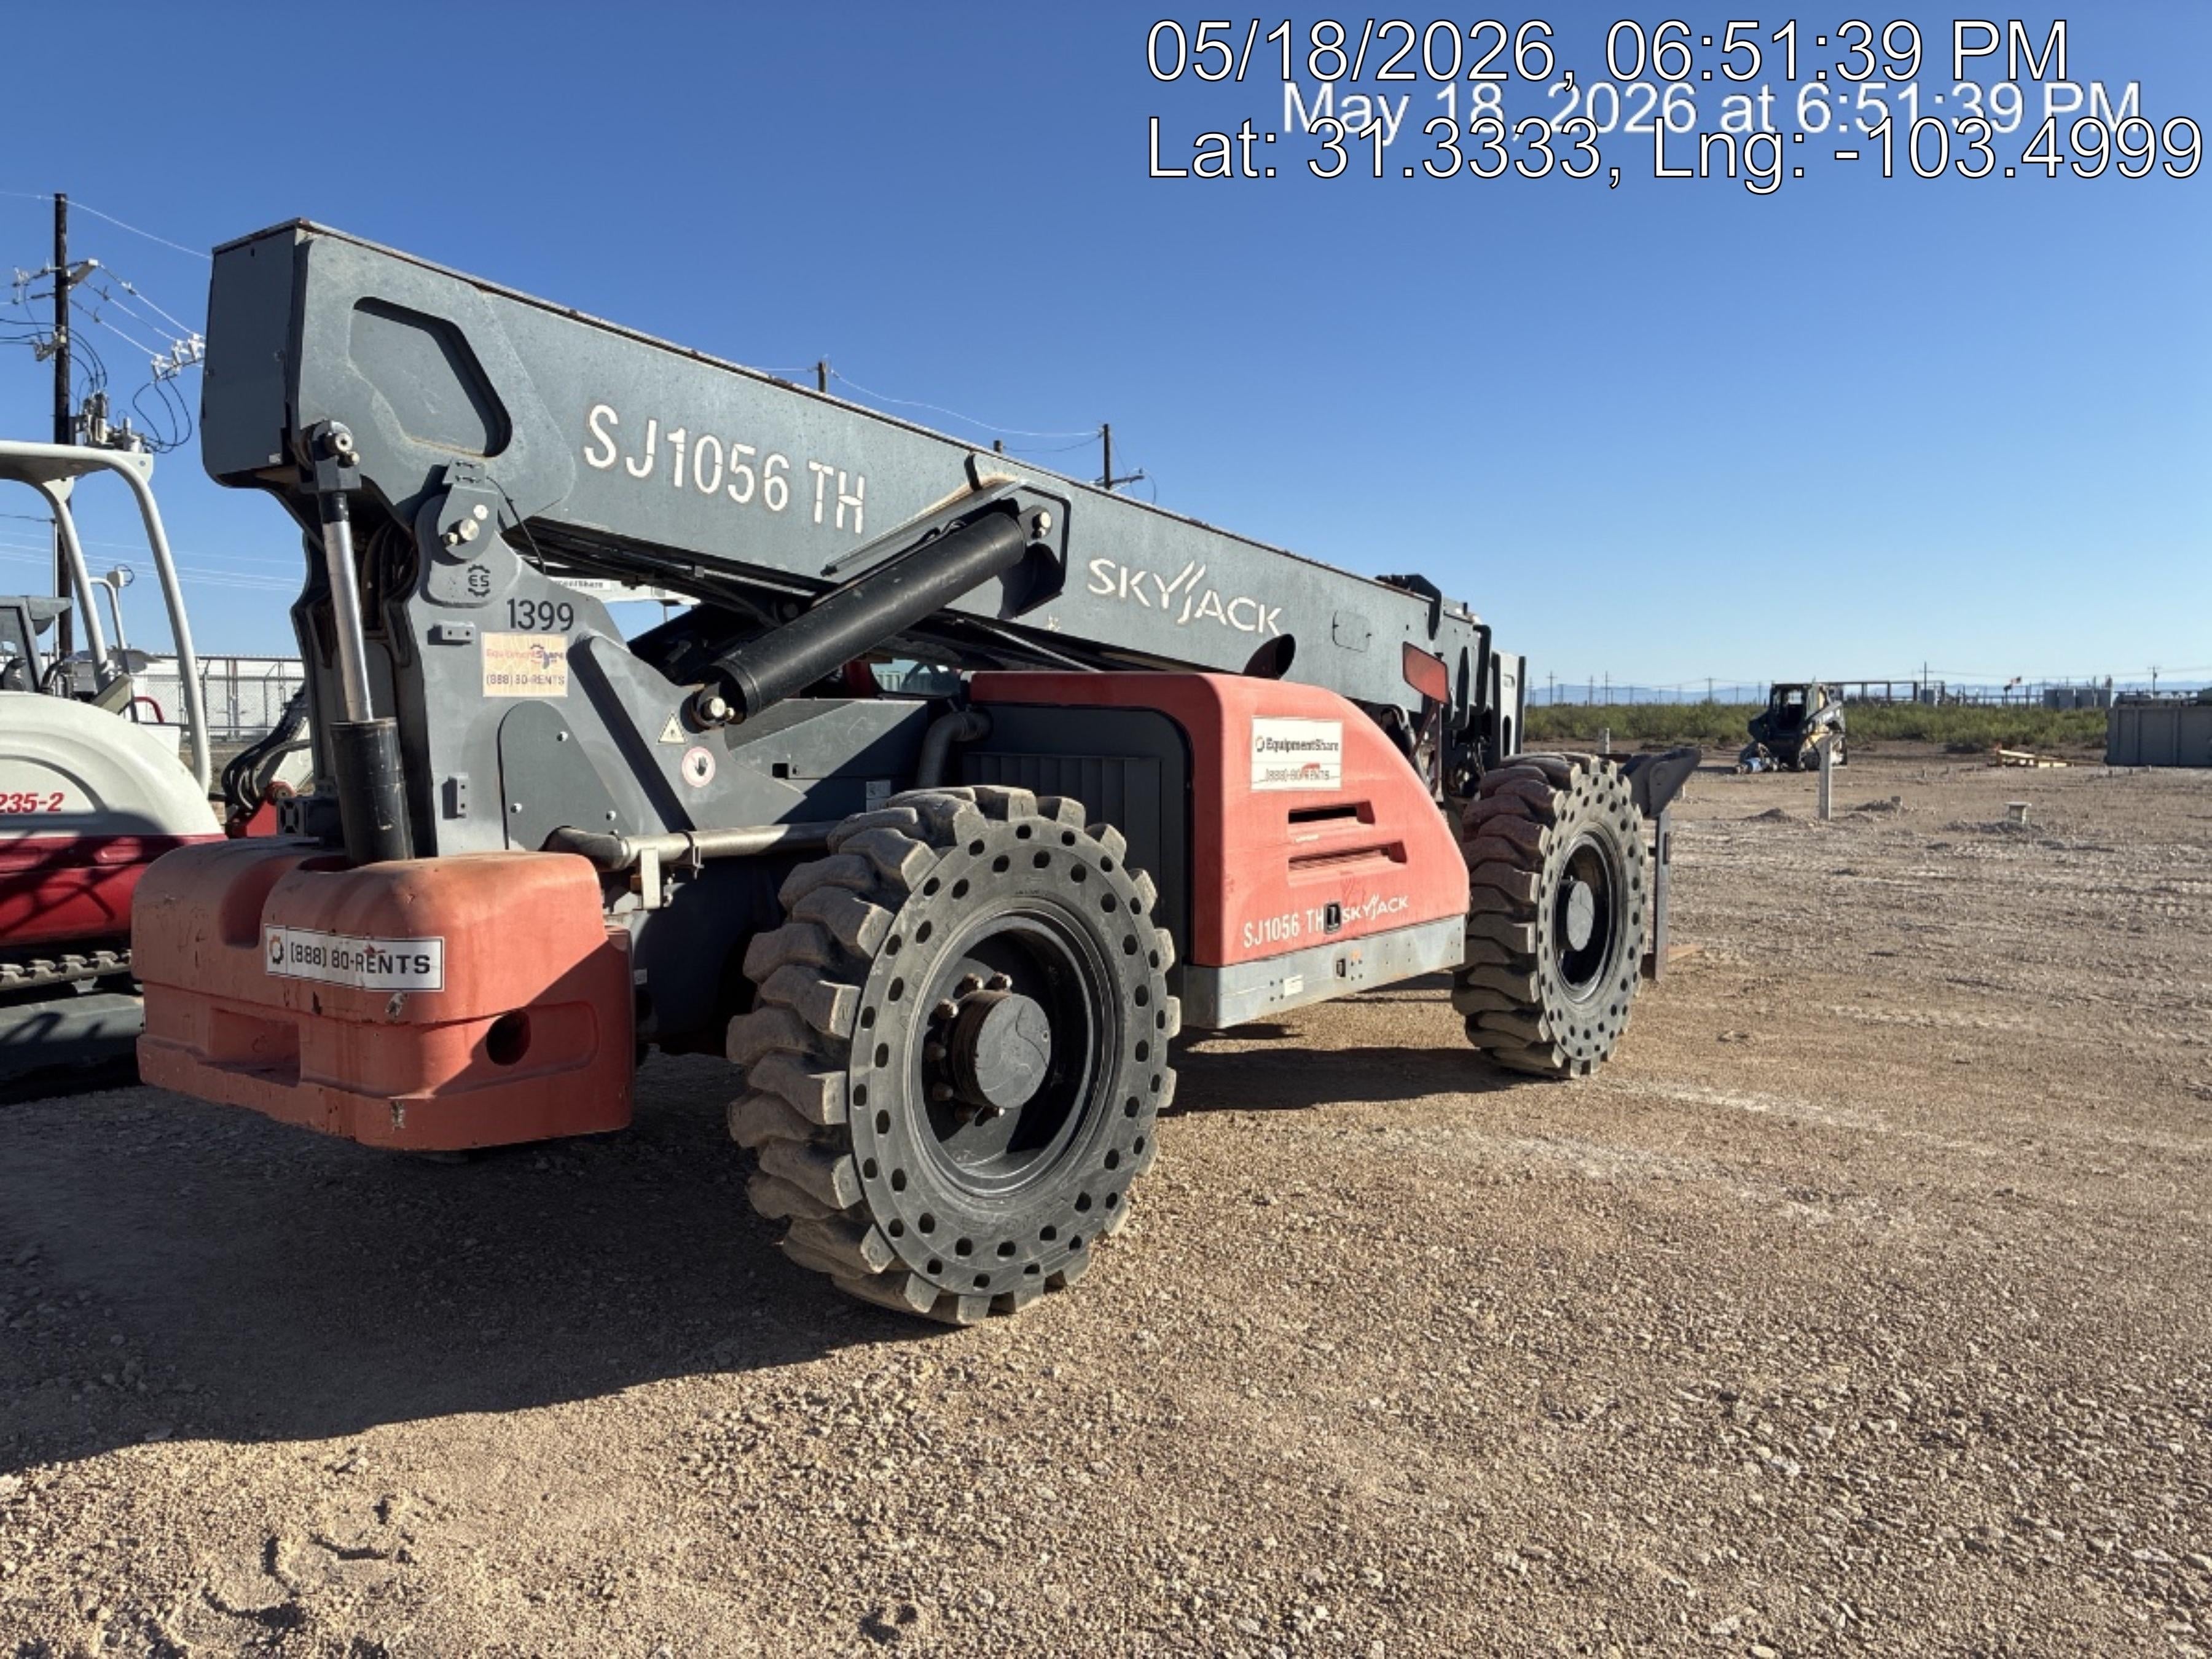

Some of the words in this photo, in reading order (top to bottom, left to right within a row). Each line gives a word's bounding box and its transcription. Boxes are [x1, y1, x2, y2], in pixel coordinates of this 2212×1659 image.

[584, 404, 790, 512] SJ1056
[809, 460, 865, 534] TH
[468, 575, 490, 587] ES
[1088, 559, 1282, 636] SKYJACK
[507, 597, 574, 631] 1399
[1266, 737, 1339, 753] EquipmentShare
[1243, 912, 1300, 948] SJ1056
[1306, 908, 1324, 933] TH
[1342, 894, 1409, 922] SKYJACK
[291, 942, 326, 968] (888)
[331, 947, 430, 975] 80-RENTS
